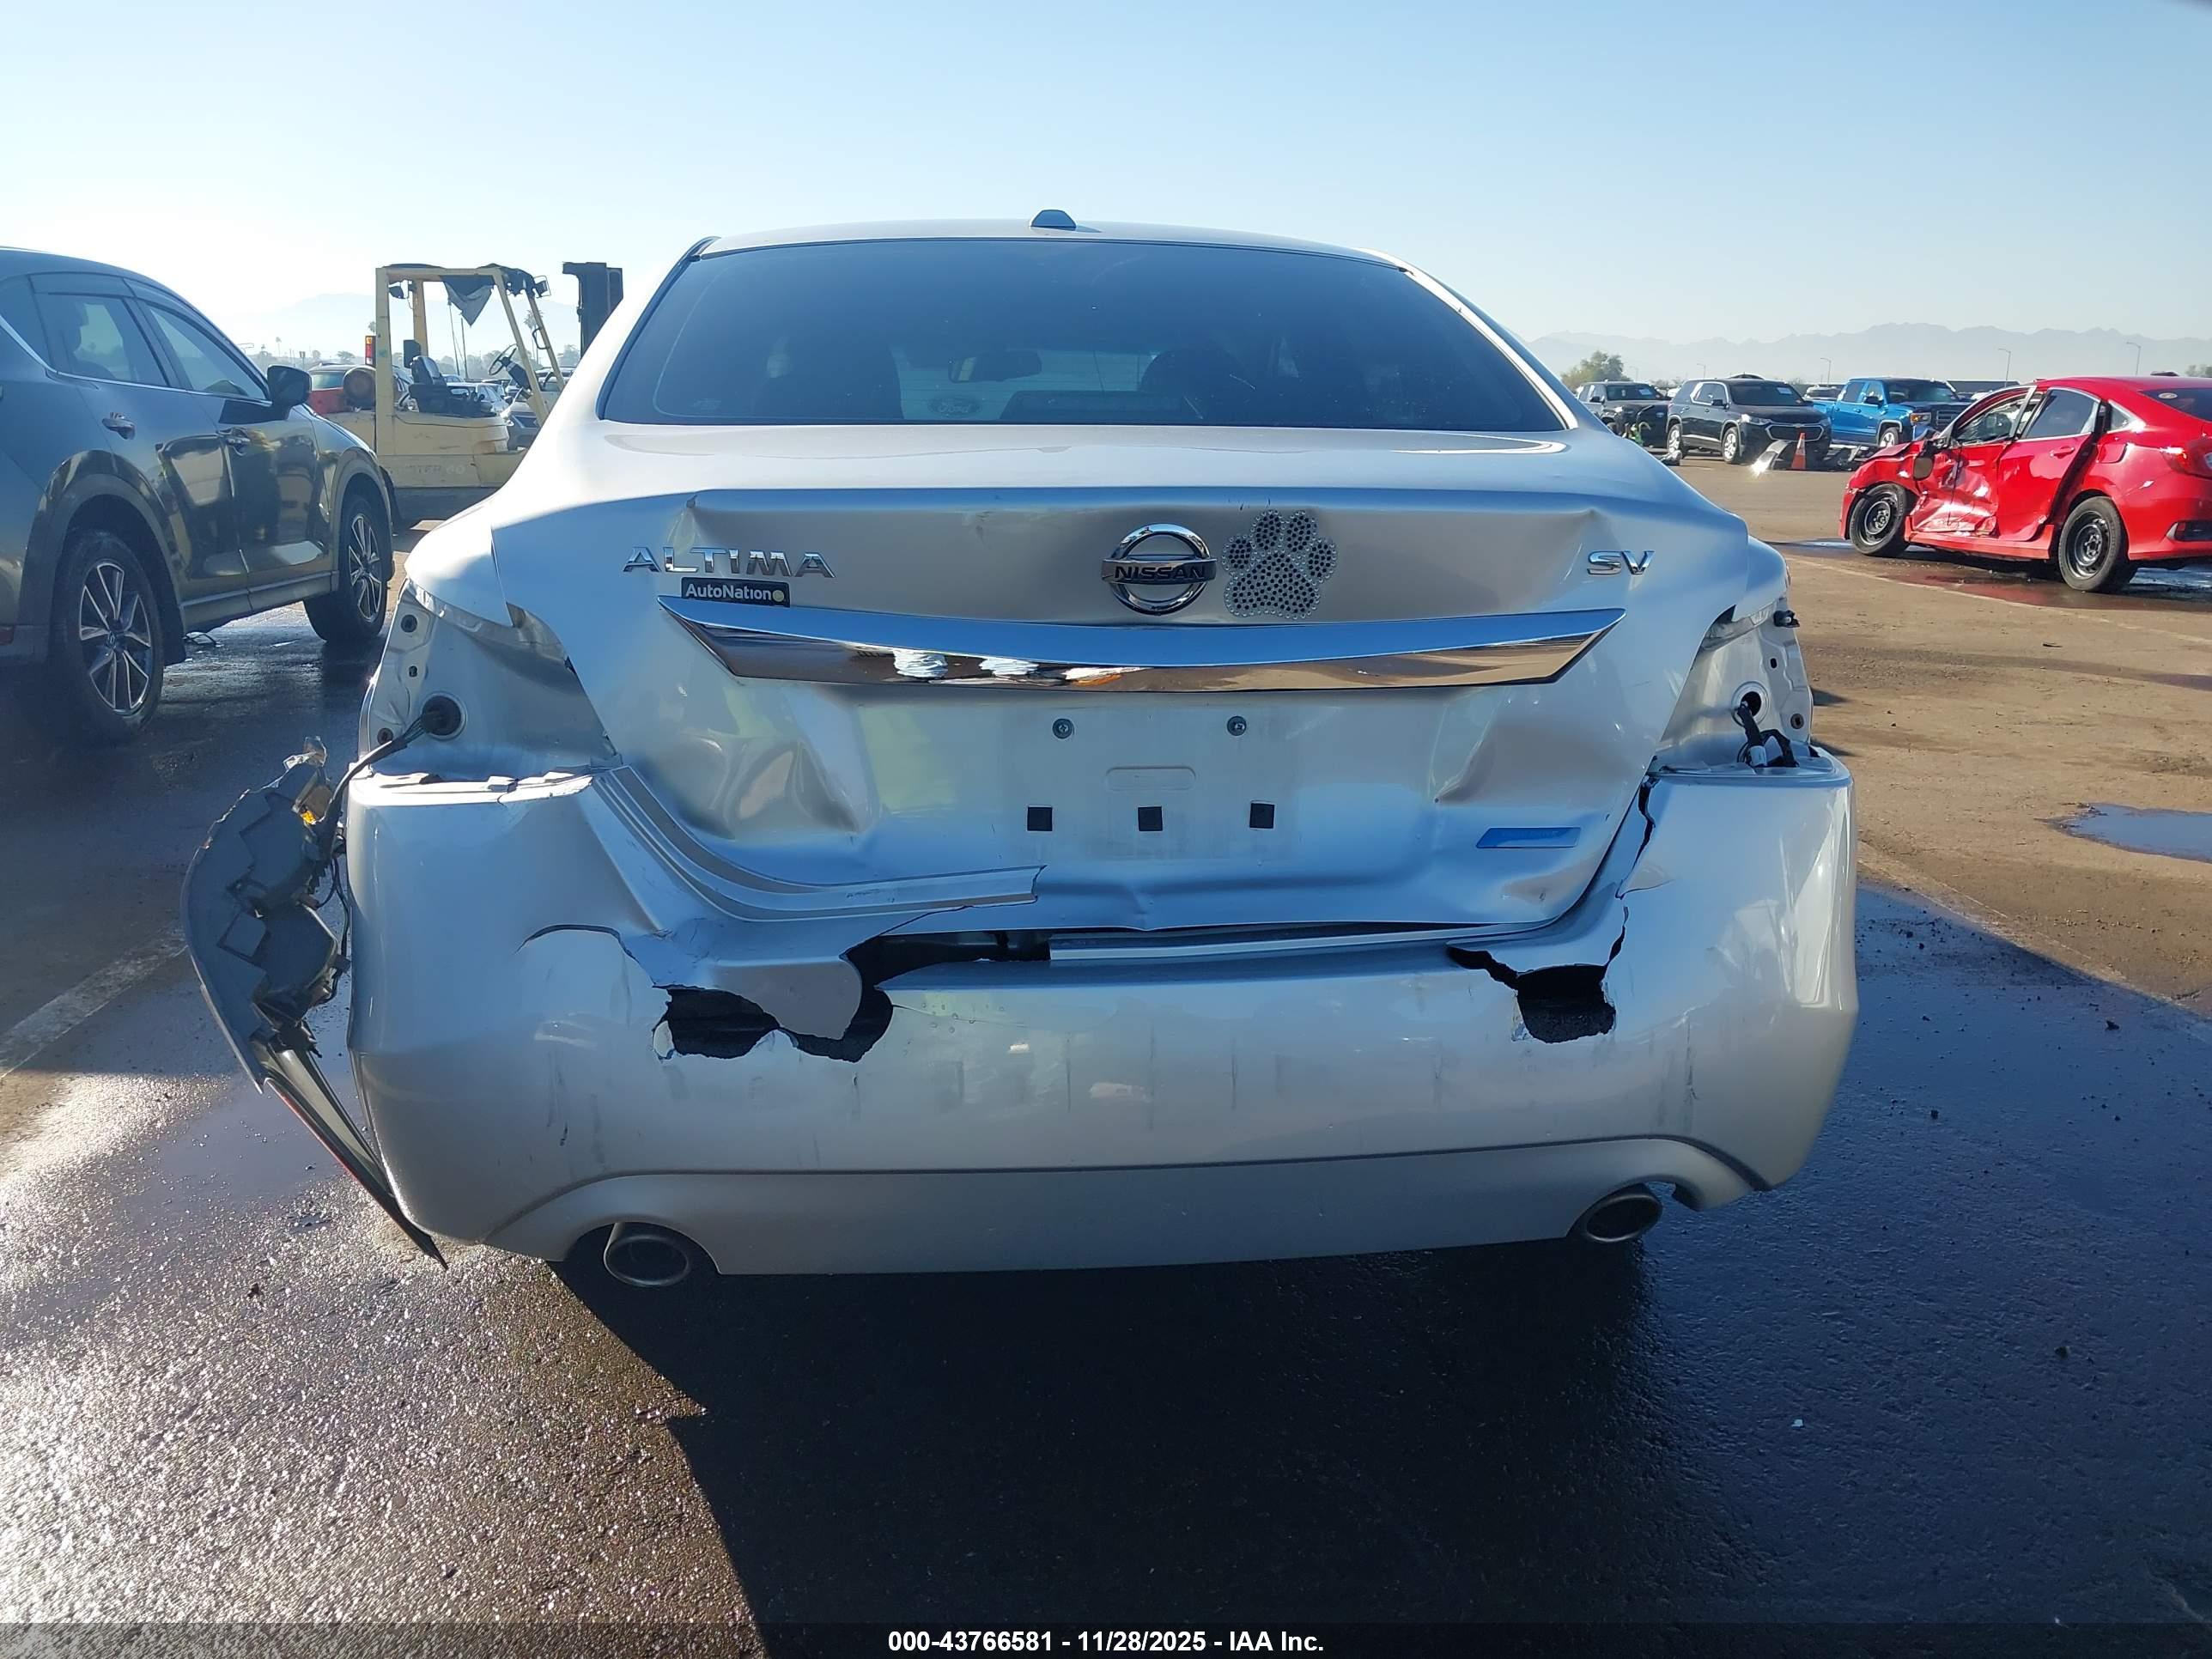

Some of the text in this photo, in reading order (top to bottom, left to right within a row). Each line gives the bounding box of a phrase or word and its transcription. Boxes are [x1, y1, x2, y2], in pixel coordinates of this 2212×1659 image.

[623, 547, 836, 578] ALTIMA
[1115, 565, 1205, 580] NISSAN
[1586, 550, 1656, 575] SV
[686, 583, 773, 601] AutoNation
